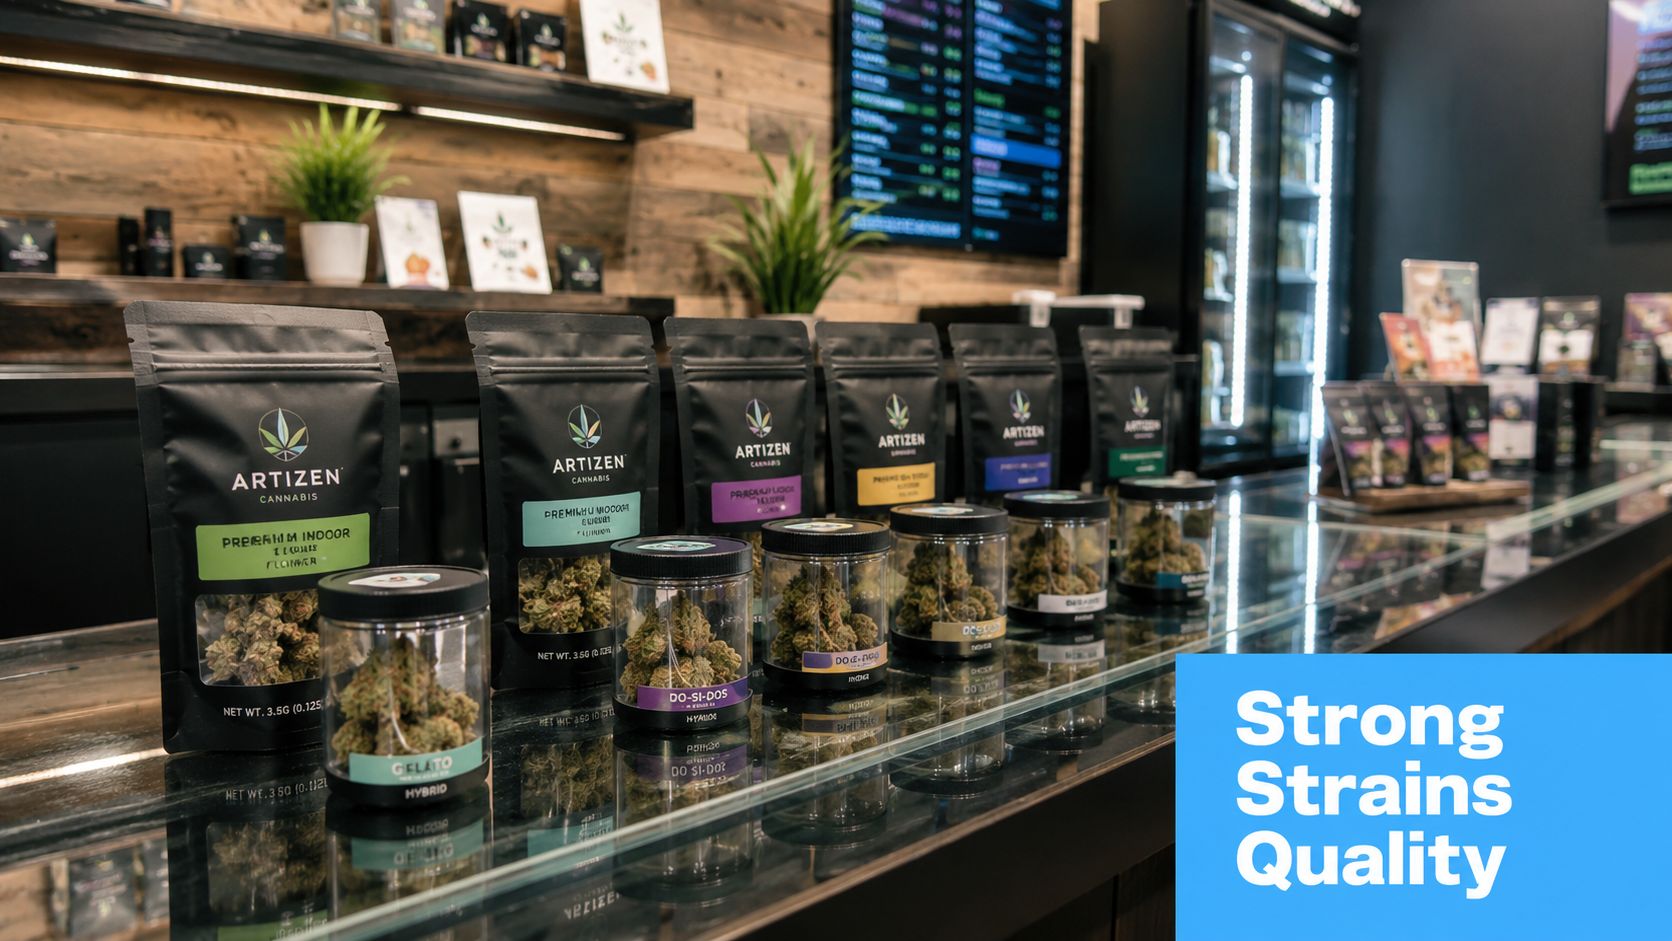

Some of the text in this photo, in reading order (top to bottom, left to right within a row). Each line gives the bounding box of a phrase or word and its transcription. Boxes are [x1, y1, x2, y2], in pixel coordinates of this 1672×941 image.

[1003, 425, 1044, 439] ARTIZEN
[878, 433, 925, 448] ARTIZEN
[735, 442, 791, 459] ARTIZEN
[552, 455, 625, 473] ARTIZEN
[231, 468, 341, 491] ARTIZEN
[259, 492, 318, 504] CANNABIS
[302, 527, 351, 541] INDOOR
[537, 652, 554, 660] NET
[670, 689, 728, 703] DO-SI-DOS
[223, 707, 242, 717] NET
[245, 707, 265, 717] WT.
[266, 705, 290, 717] 3.5G
[391, 756, 453, 776] GELATO
[405, 783, 447, 799] HYBRID
